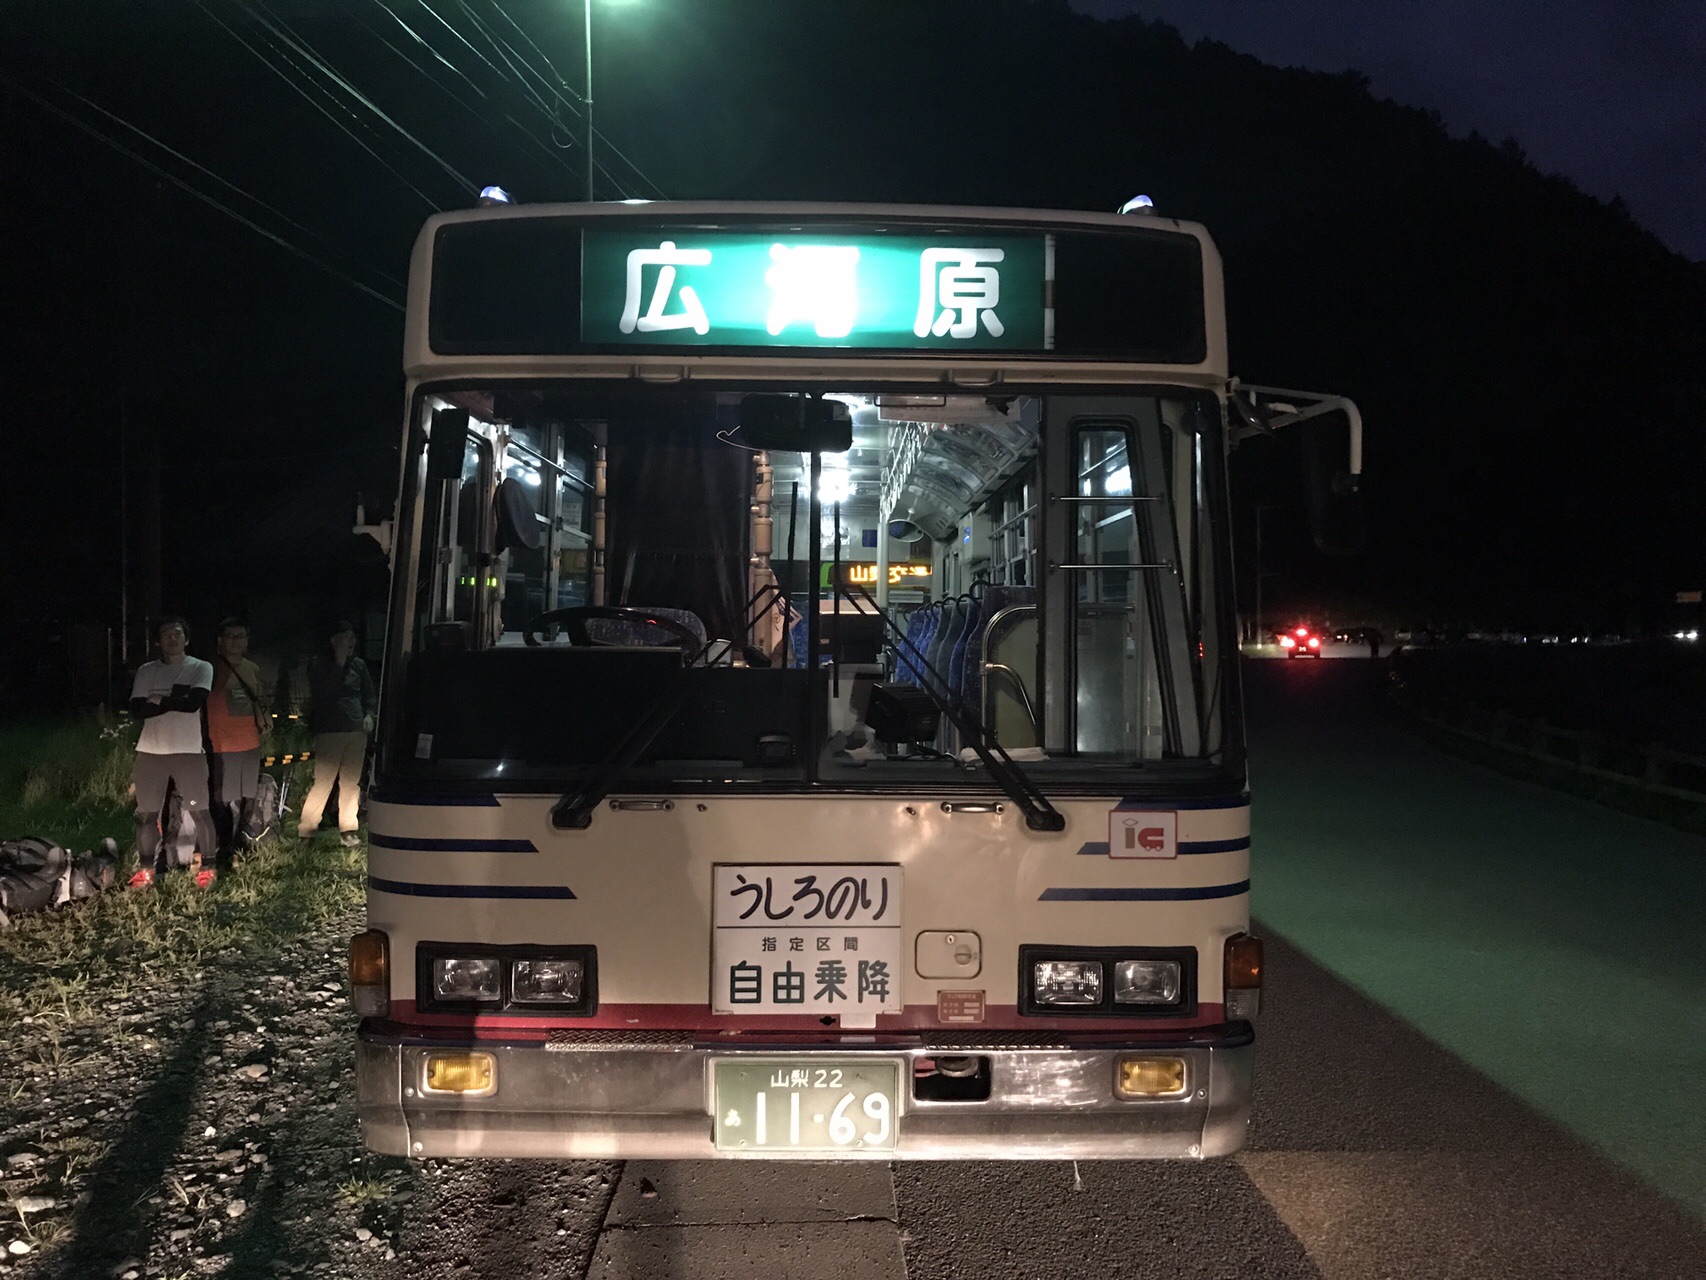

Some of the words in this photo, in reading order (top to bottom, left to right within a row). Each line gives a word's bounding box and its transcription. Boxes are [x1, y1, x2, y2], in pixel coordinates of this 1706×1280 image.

[730, 874, 888, 920] うしろのり
[762, 937, 858, 952] 指定区間
[730, 960, 890, 1003] 自由乗降
[771, 1070, 809, 1088] 山梨
[814, 1070, 843, 1088] 22
